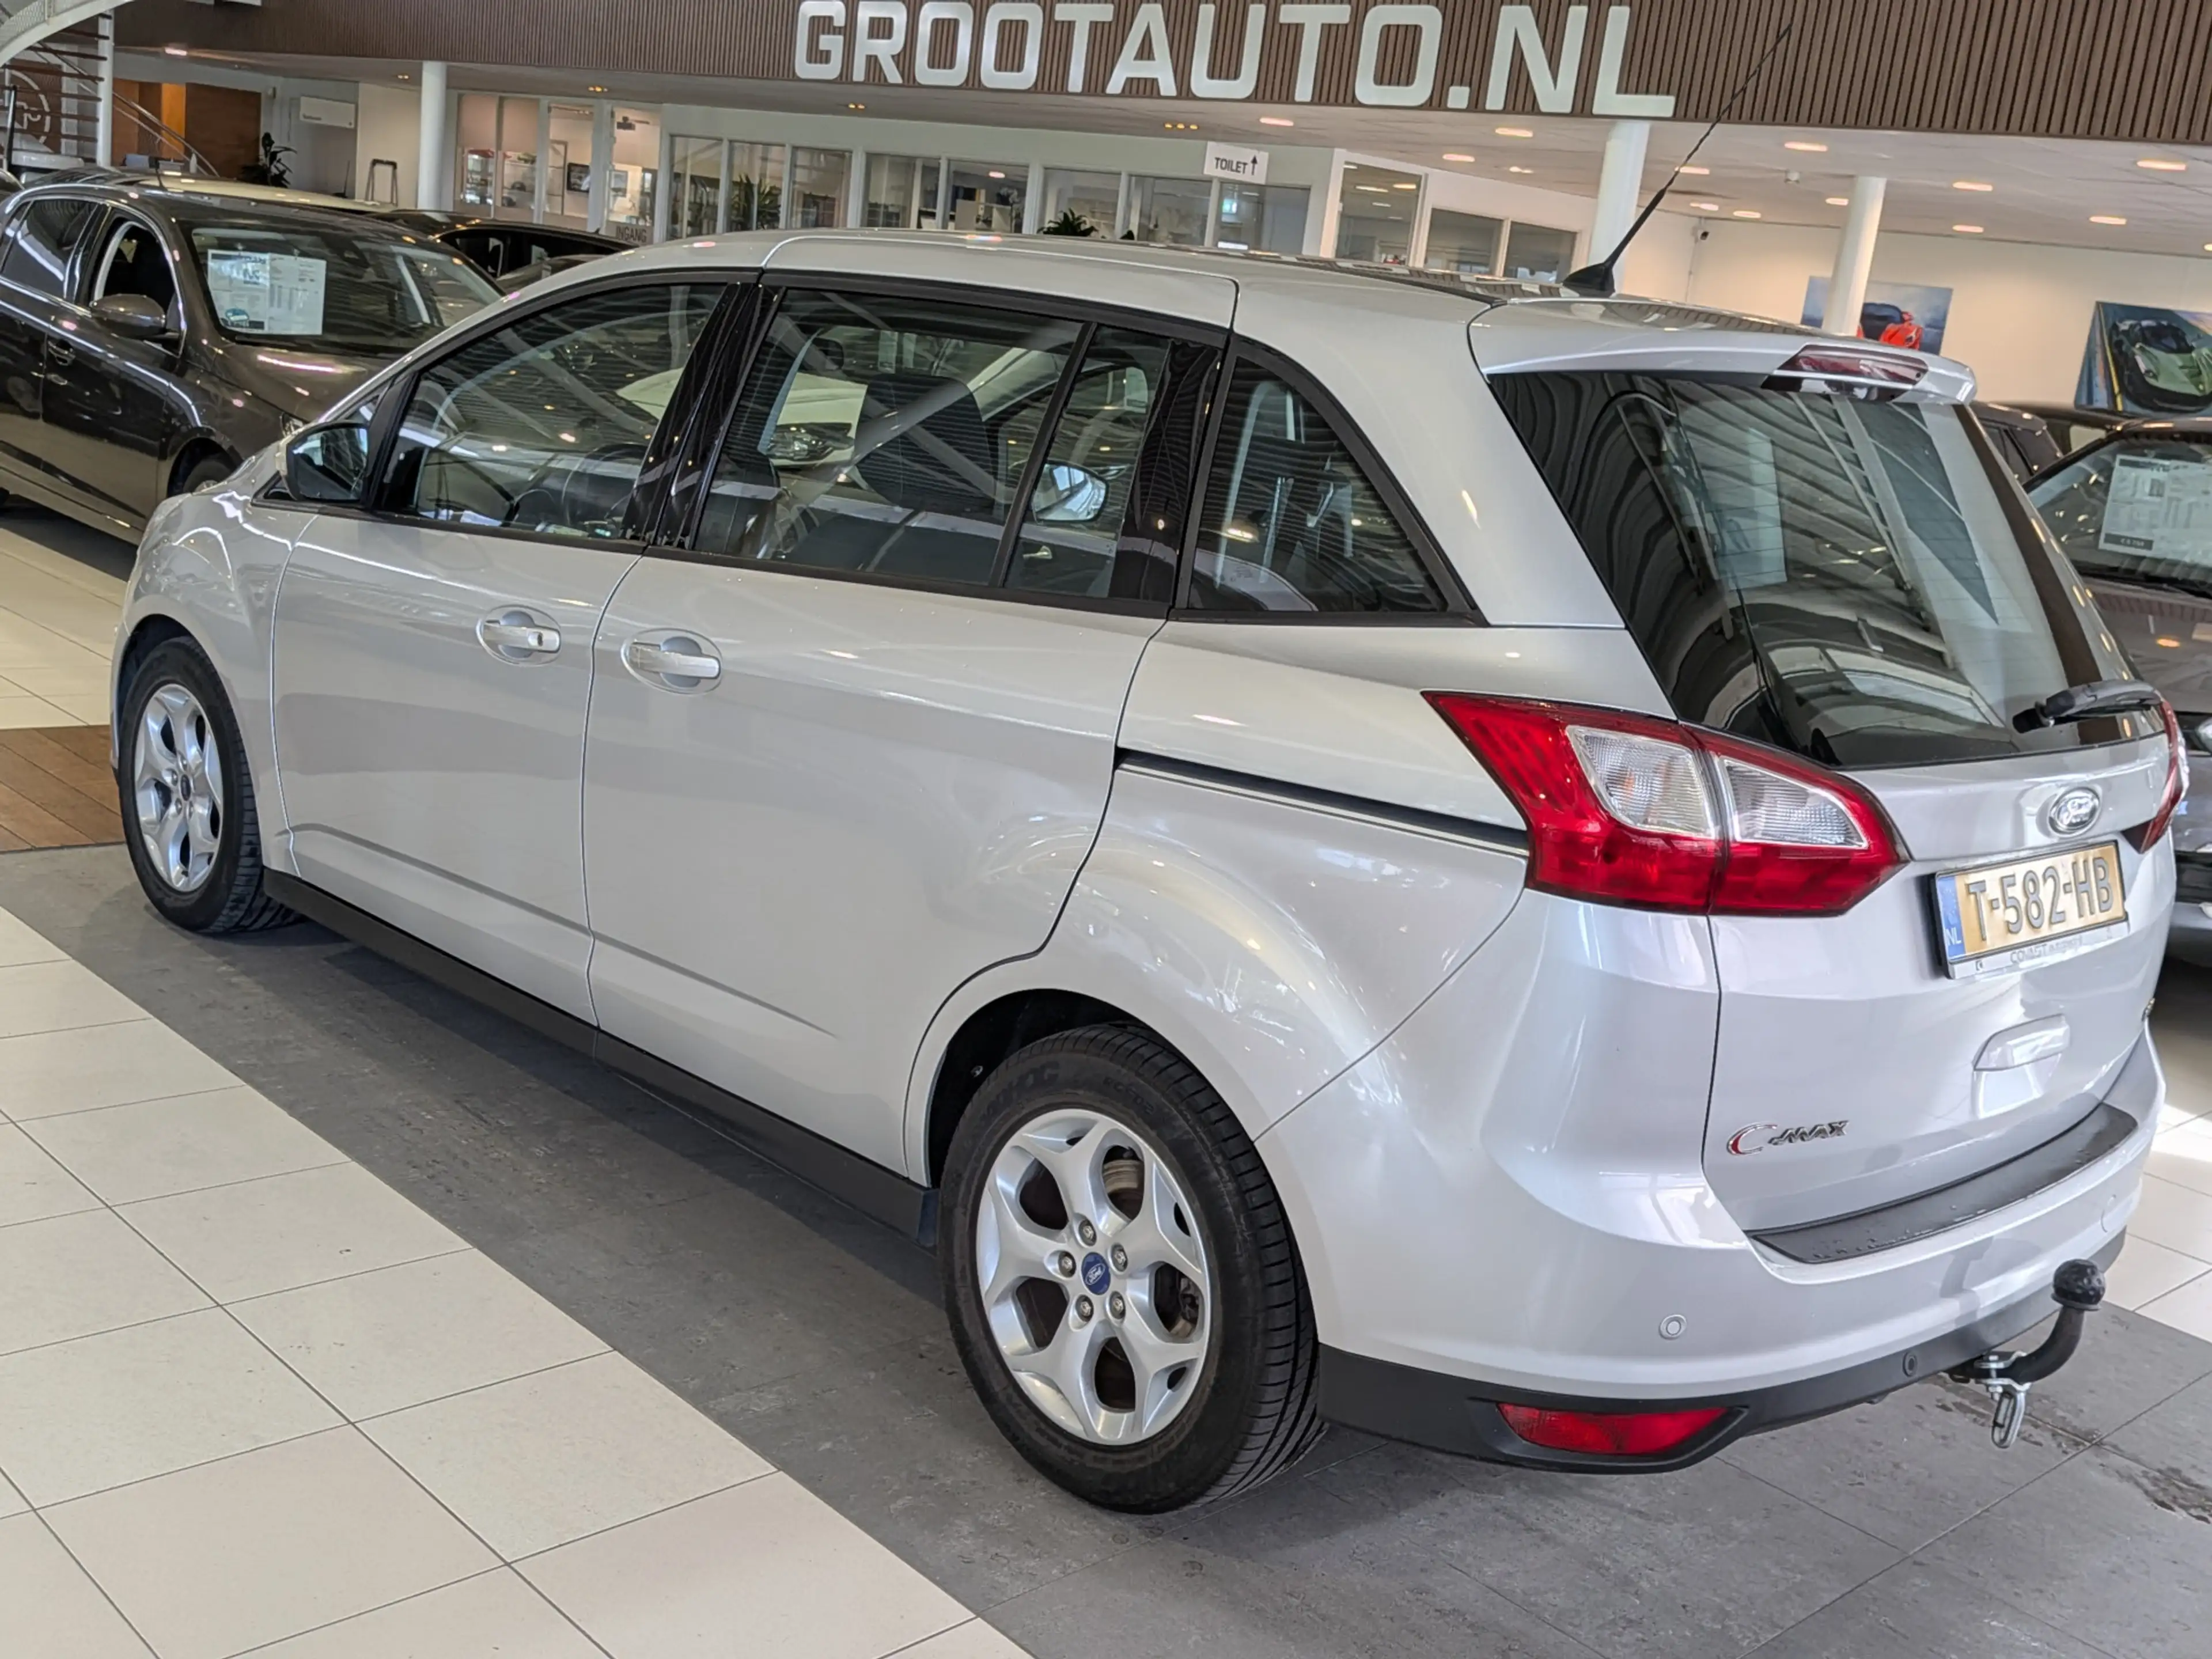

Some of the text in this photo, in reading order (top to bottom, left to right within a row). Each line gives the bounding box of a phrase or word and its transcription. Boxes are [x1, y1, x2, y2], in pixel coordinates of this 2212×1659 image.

[795, 1, 1675, 118] GROOTAUTO.NL
[1215, 157, 1248, 175] TOILET
[616, 225, 647, 243] INGANG
[1968, 857, 2114, 942] T-582-HB
[1945, 926, 1962, 945] NL
